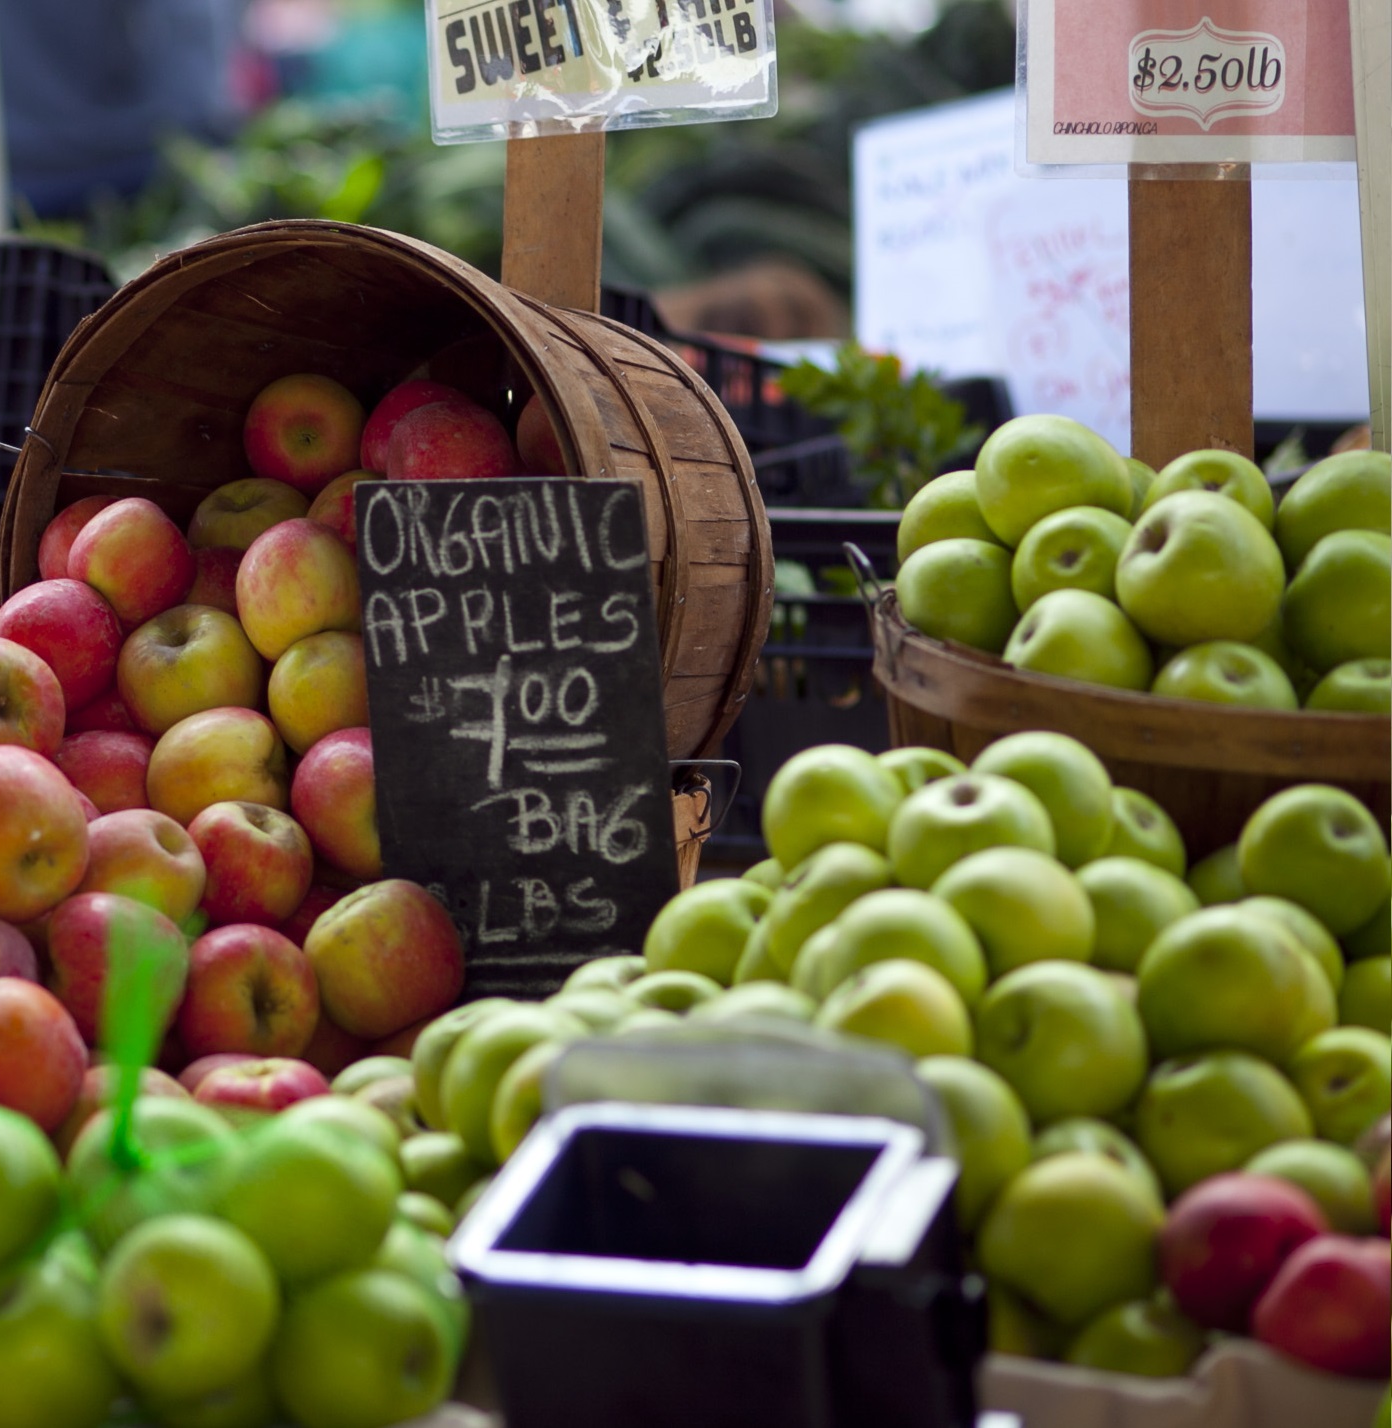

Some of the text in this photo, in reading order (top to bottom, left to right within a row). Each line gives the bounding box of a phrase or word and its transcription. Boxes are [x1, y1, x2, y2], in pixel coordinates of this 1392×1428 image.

[1133, 46, 1281, 97] $2.50lb
[363, 483, 646, 576] ORGANIC
[365, 588, 639, 667] APPLES
[471, 782, 654, 865] BAG
[477, 876, 617, 945] LBS
